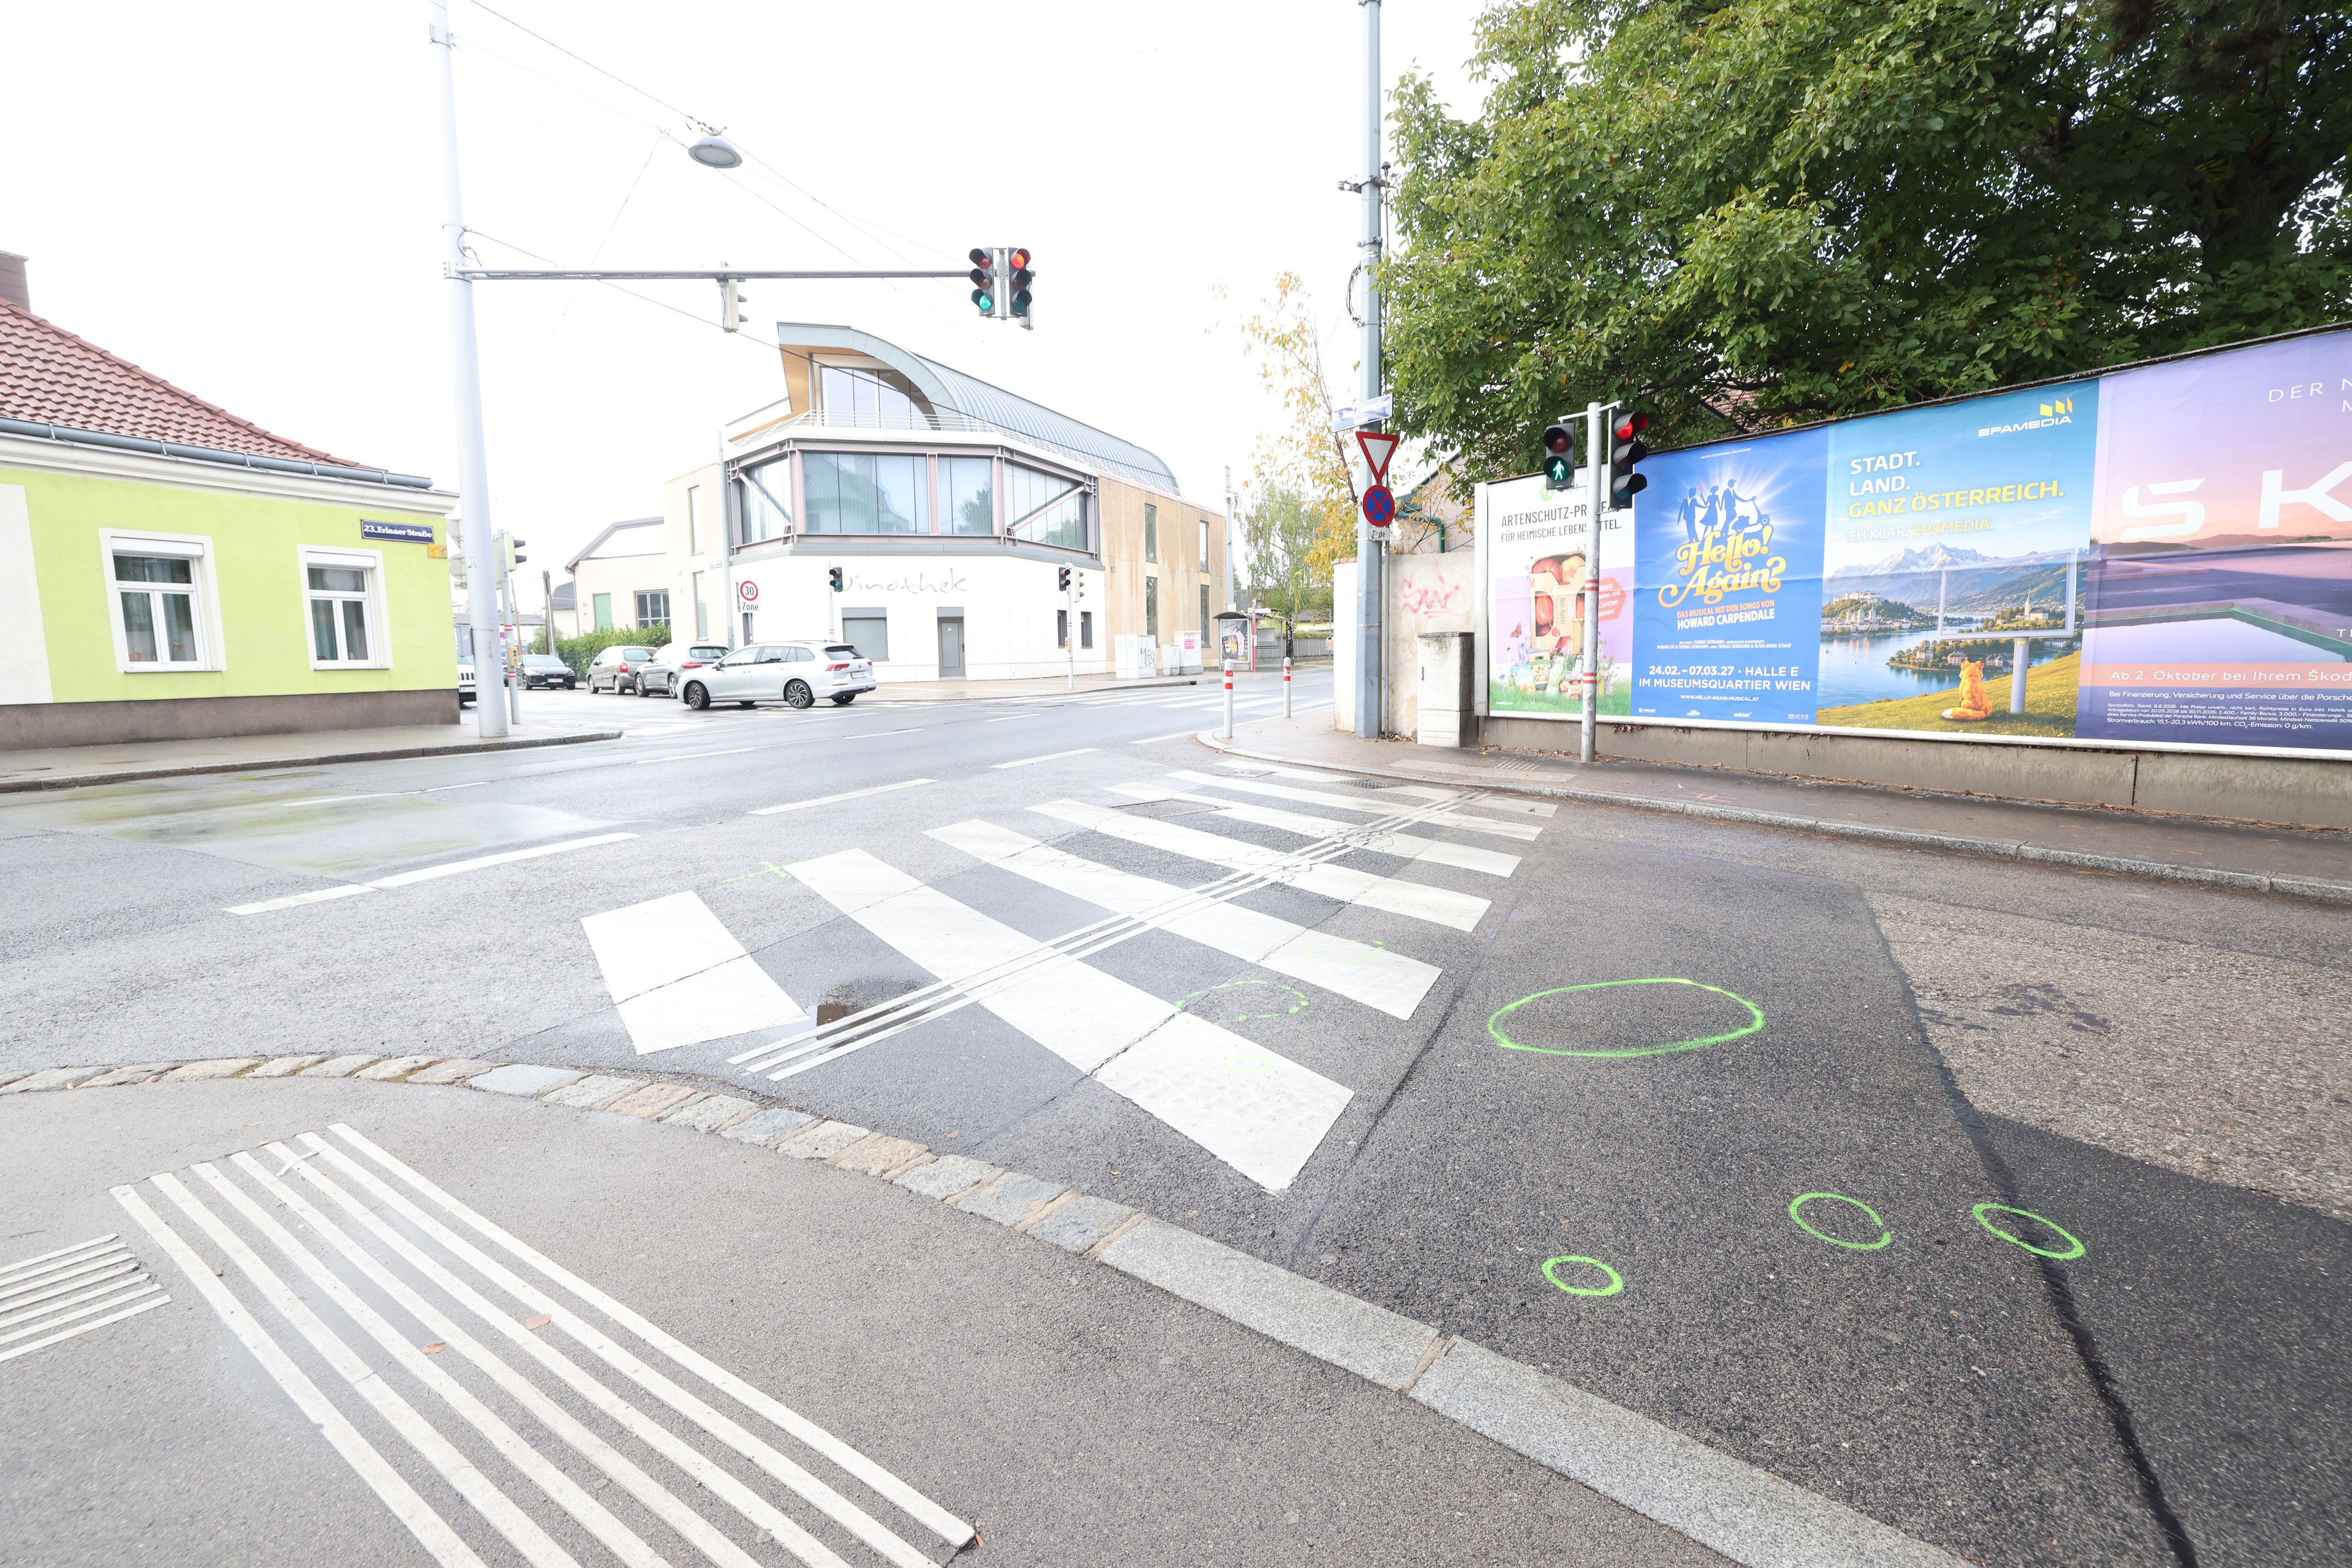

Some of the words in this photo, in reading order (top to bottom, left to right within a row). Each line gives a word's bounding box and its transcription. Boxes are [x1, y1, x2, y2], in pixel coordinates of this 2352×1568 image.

[2269, 382, 2323, 403] DER
[1978, 416, 2072, 437] EPAMEDIA
[1850, 450, 1921, 475] STADT.
[1849, 475, 1910, 497] LAND.
[1849, 498, 1906, 519] GANZ
[1912, 480, 2065, 511] ÖSTERREICH.
[377, 526, 406, 536] Erlaaer
[407, 529, 432, 538] Straße
[1501, 531, 1515, 543] FÜR
[1517, 527, 1556, 541] HEIMISCHE
[1848, 530, 1866, 542] EH
[1870, 526, 1909, 540] KLAR.
[1913, 518, 1994, 537] EPAMEDIA.
[1676, 525, 1773, 576] Hello!
[1658, 556, 1787, 608] Again?
[745, 586, 754, 596] 30
[742, 602, 759, 611] Zone
[1600, 599, 1618, 608] Zeichen
[1689, 607, 1714, 617] MUSICAL
[1726, 604, 1738, 613] DEN
[1739, 601, 1759, 611] SONGS
[1761, 600, 1775, 608] VON
[1678, 616, 1715, 630] HOWARD
[1716, 609, 1775, 626] CARPENDALE
[1745, 666, 1786, 676] HALLE
[1790, 667, 1799, 677] E
[2110, 671, 2130, 680] Ab
[2135, 671, 2147, 680] 2.
[2154, 670, 2217, 681] Oktober
[2223, 671, 2246, 681] bei
[2253, 671, 2300, 681] Ihrem
[1639, 678, 1651, 687] IM
[1653, 678, 1771, 690] MUSEUMSQUARTIER
[1775, 680, 1810, 691] WIEN
[2123, 691, 2171, 699] Finanzierung,
[2173, 692, 2225, 700] Versicherung
